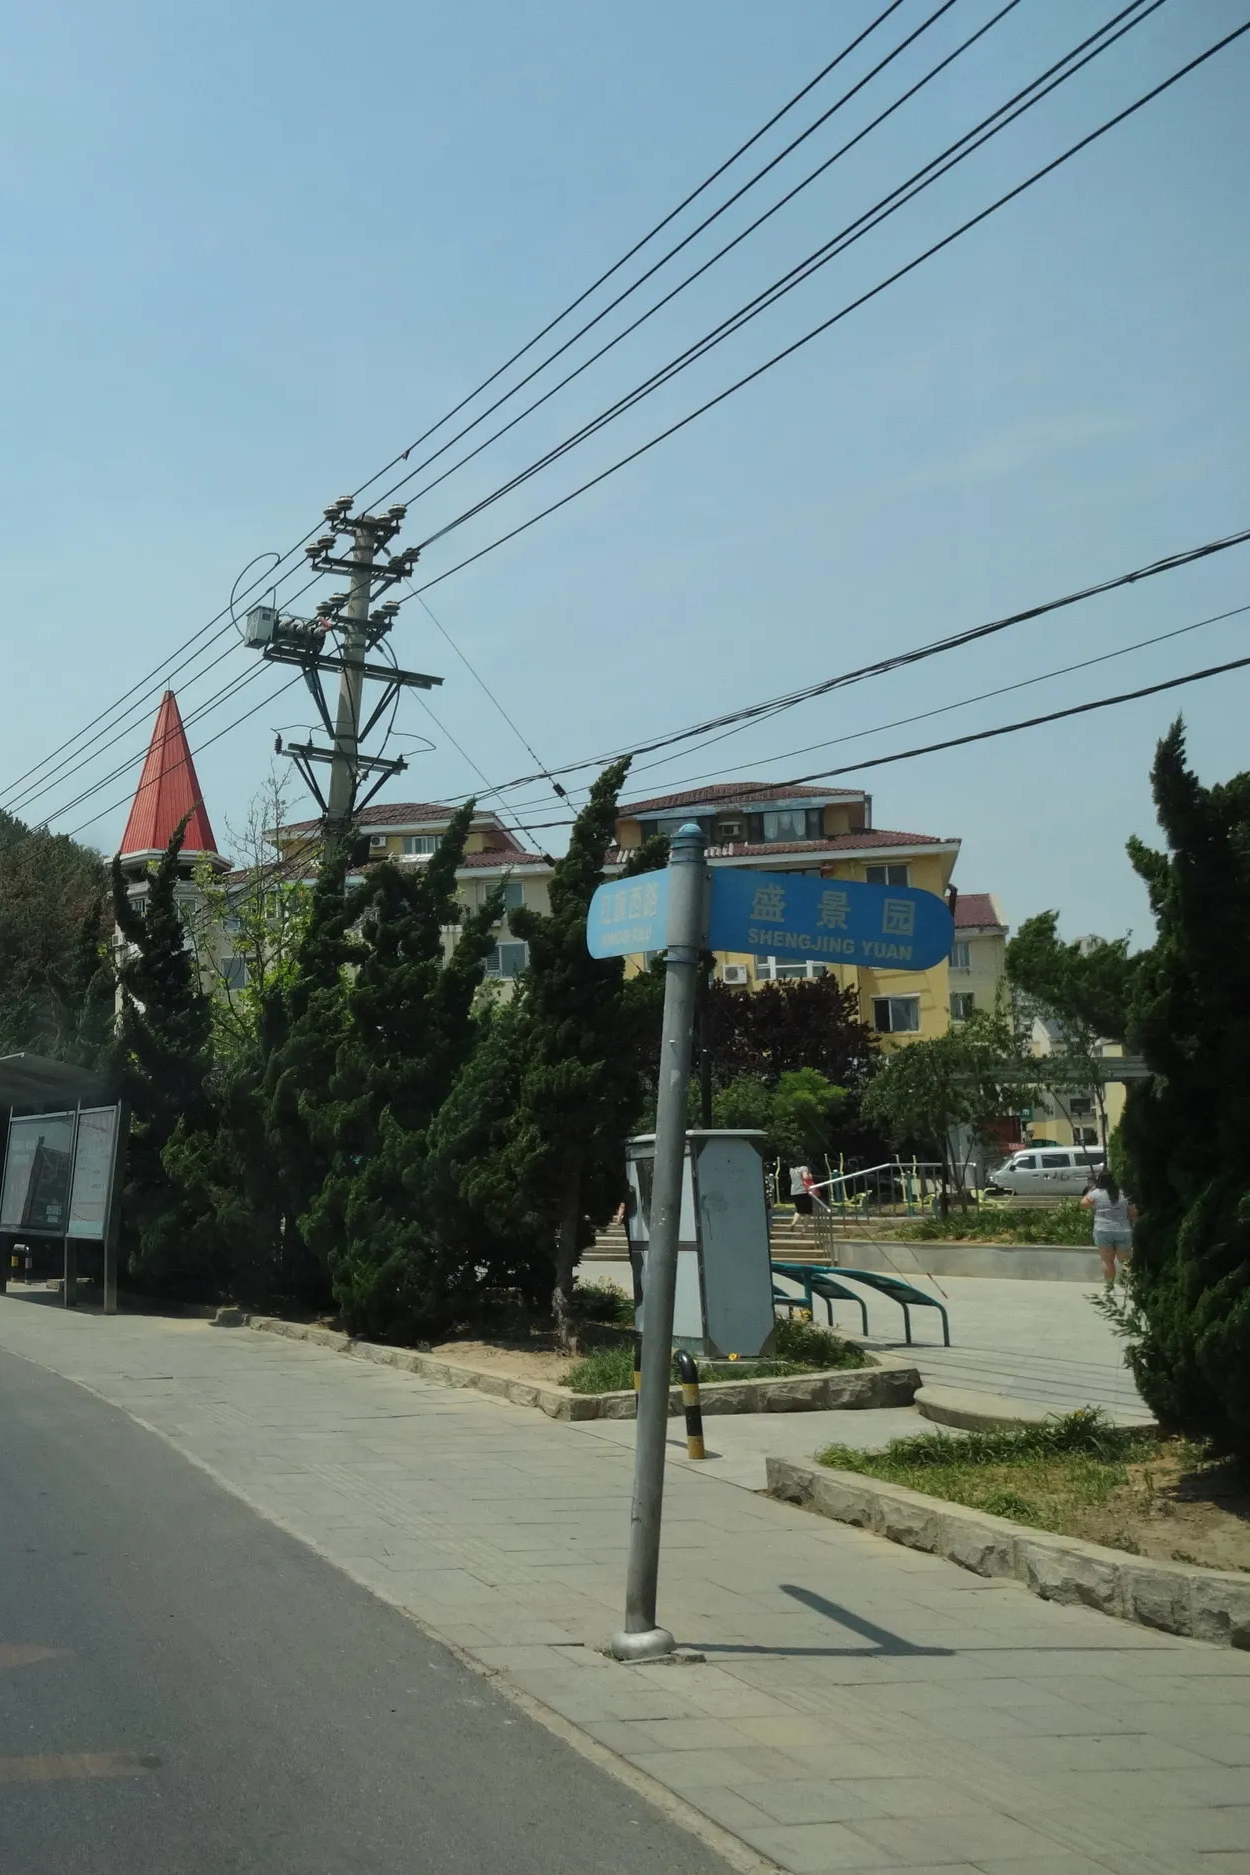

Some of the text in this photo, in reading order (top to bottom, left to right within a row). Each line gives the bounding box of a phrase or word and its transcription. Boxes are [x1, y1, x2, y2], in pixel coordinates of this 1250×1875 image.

[749, 883, 916, 937] 盛景园
[747, 927, 914, 961] SHENGJING YUAN
